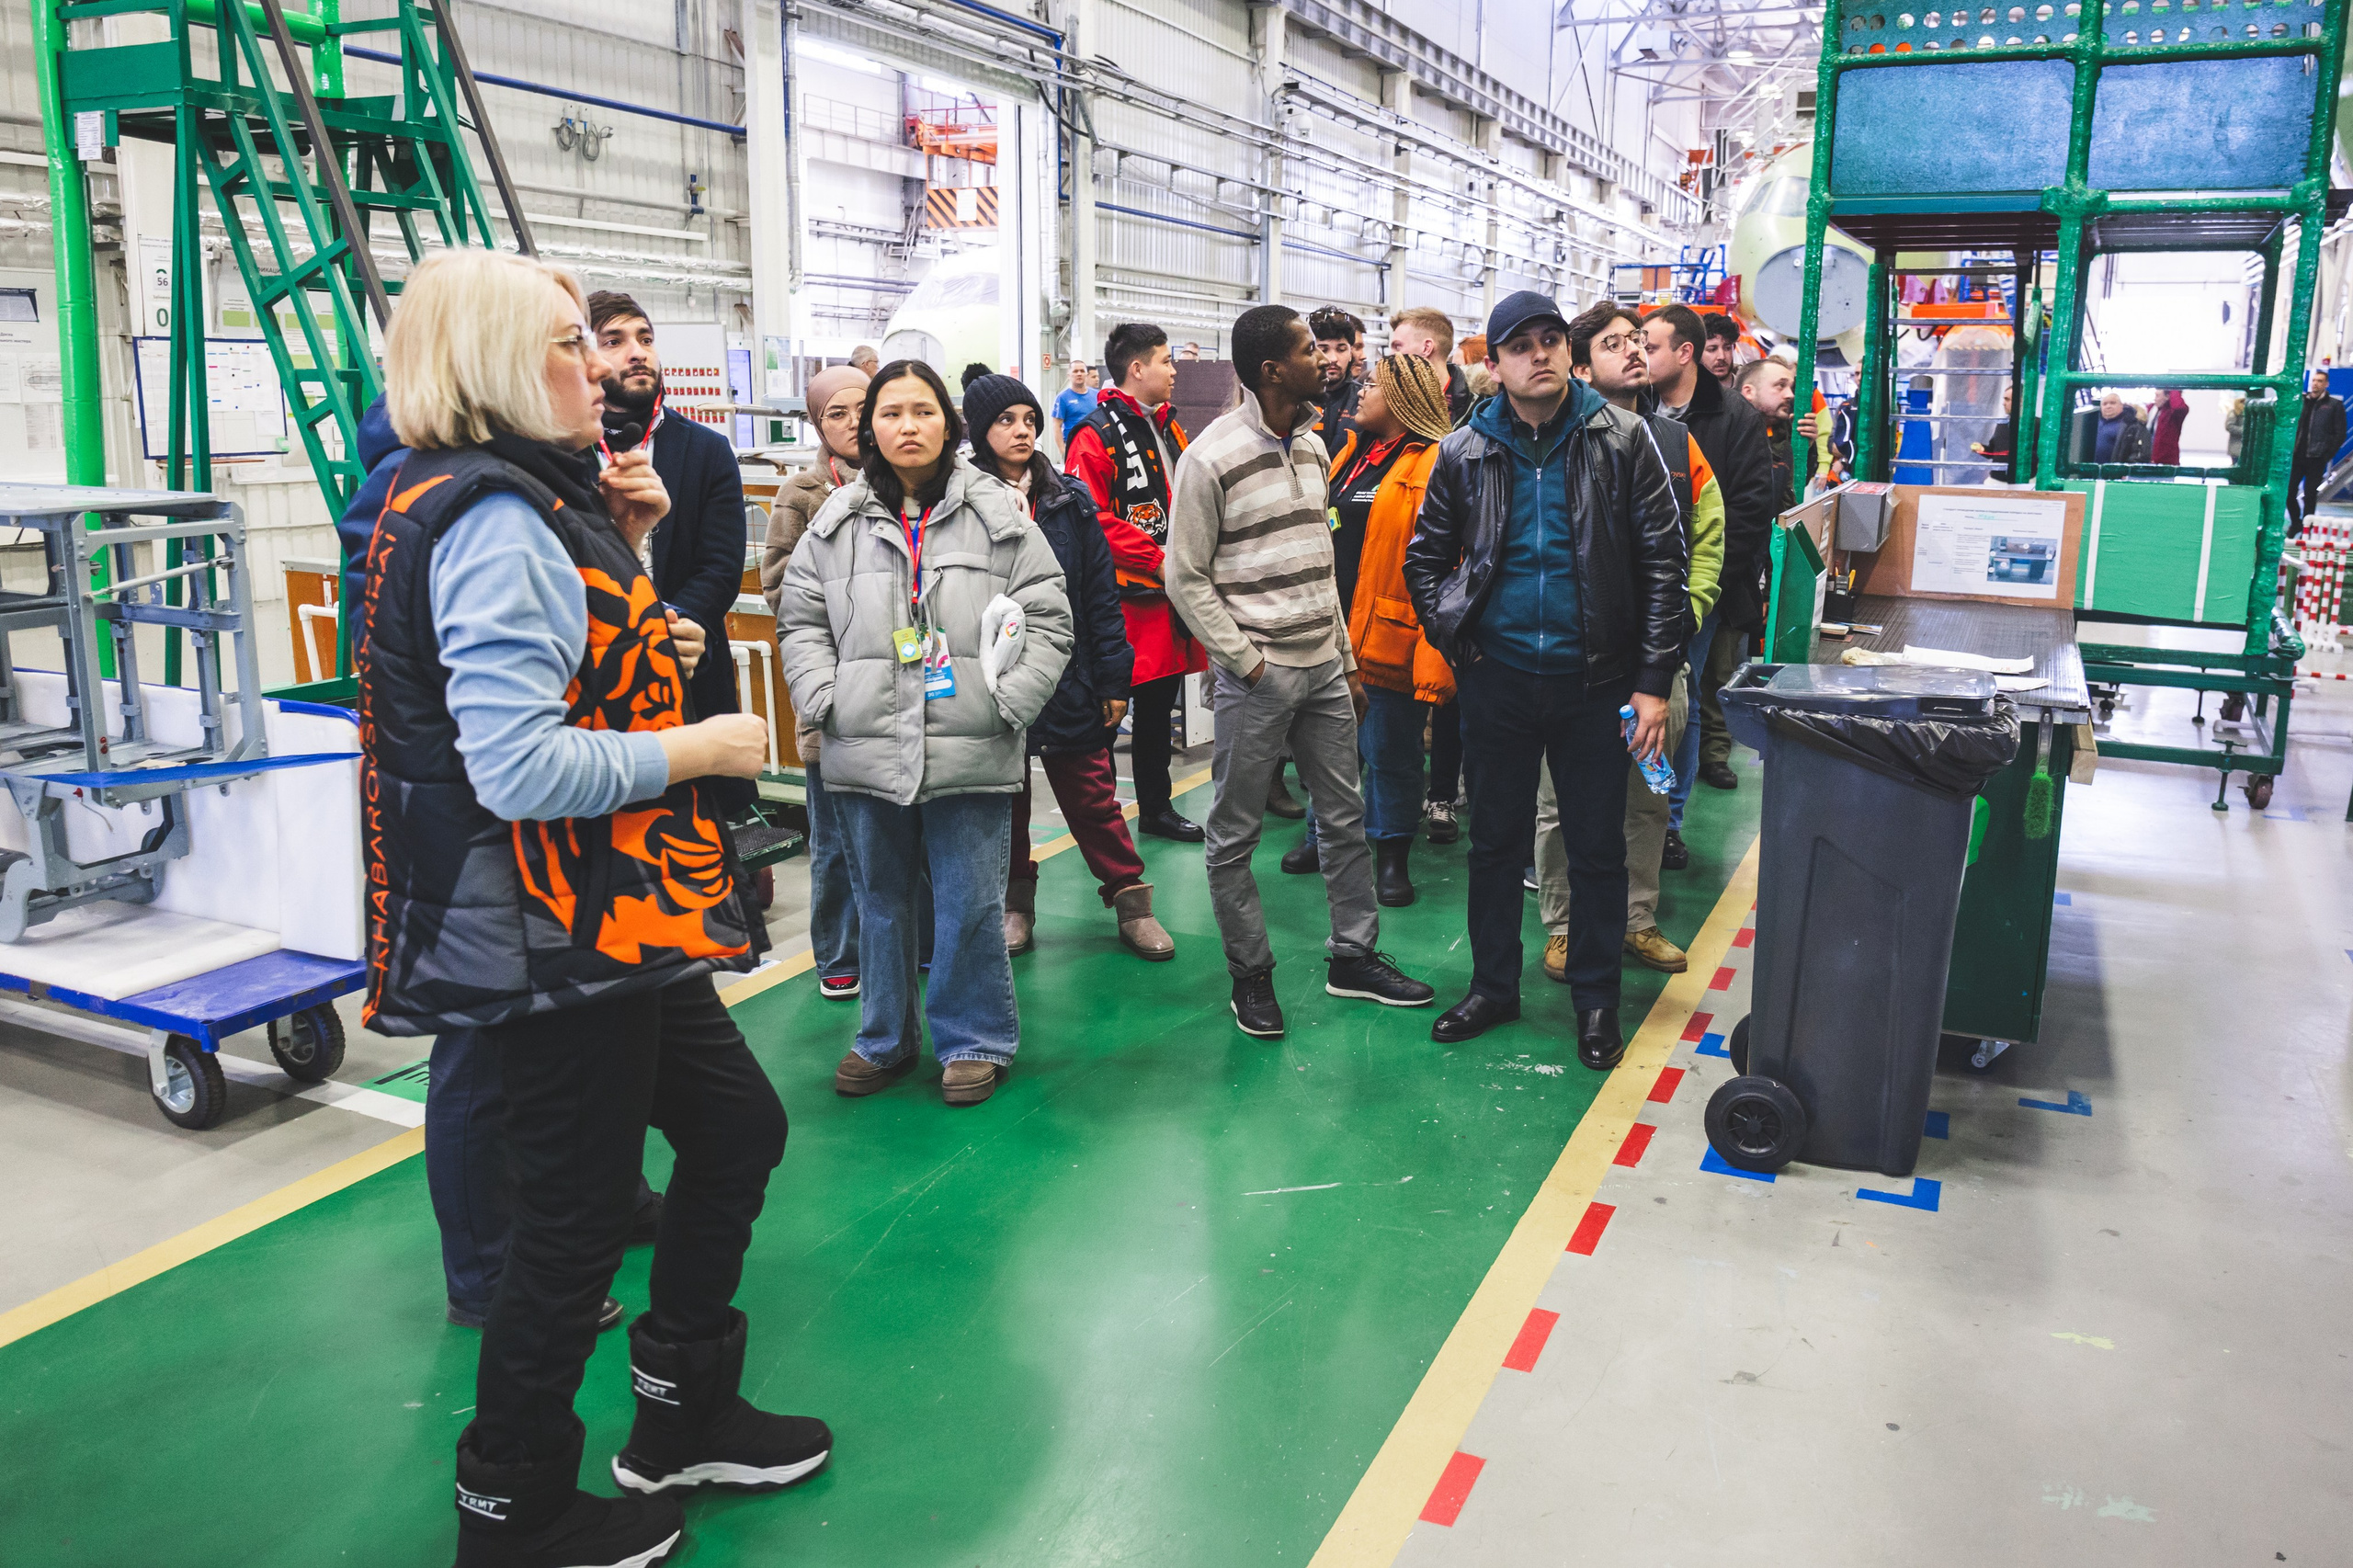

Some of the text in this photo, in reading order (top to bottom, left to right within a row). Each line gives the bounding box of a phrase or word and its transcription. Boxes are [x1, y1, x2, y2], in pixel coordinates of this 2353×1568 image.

[157, 277, 169, 287] 56
[156, 308, 169, 327] 0
[461, 1494, 497, 1513] TRMT
